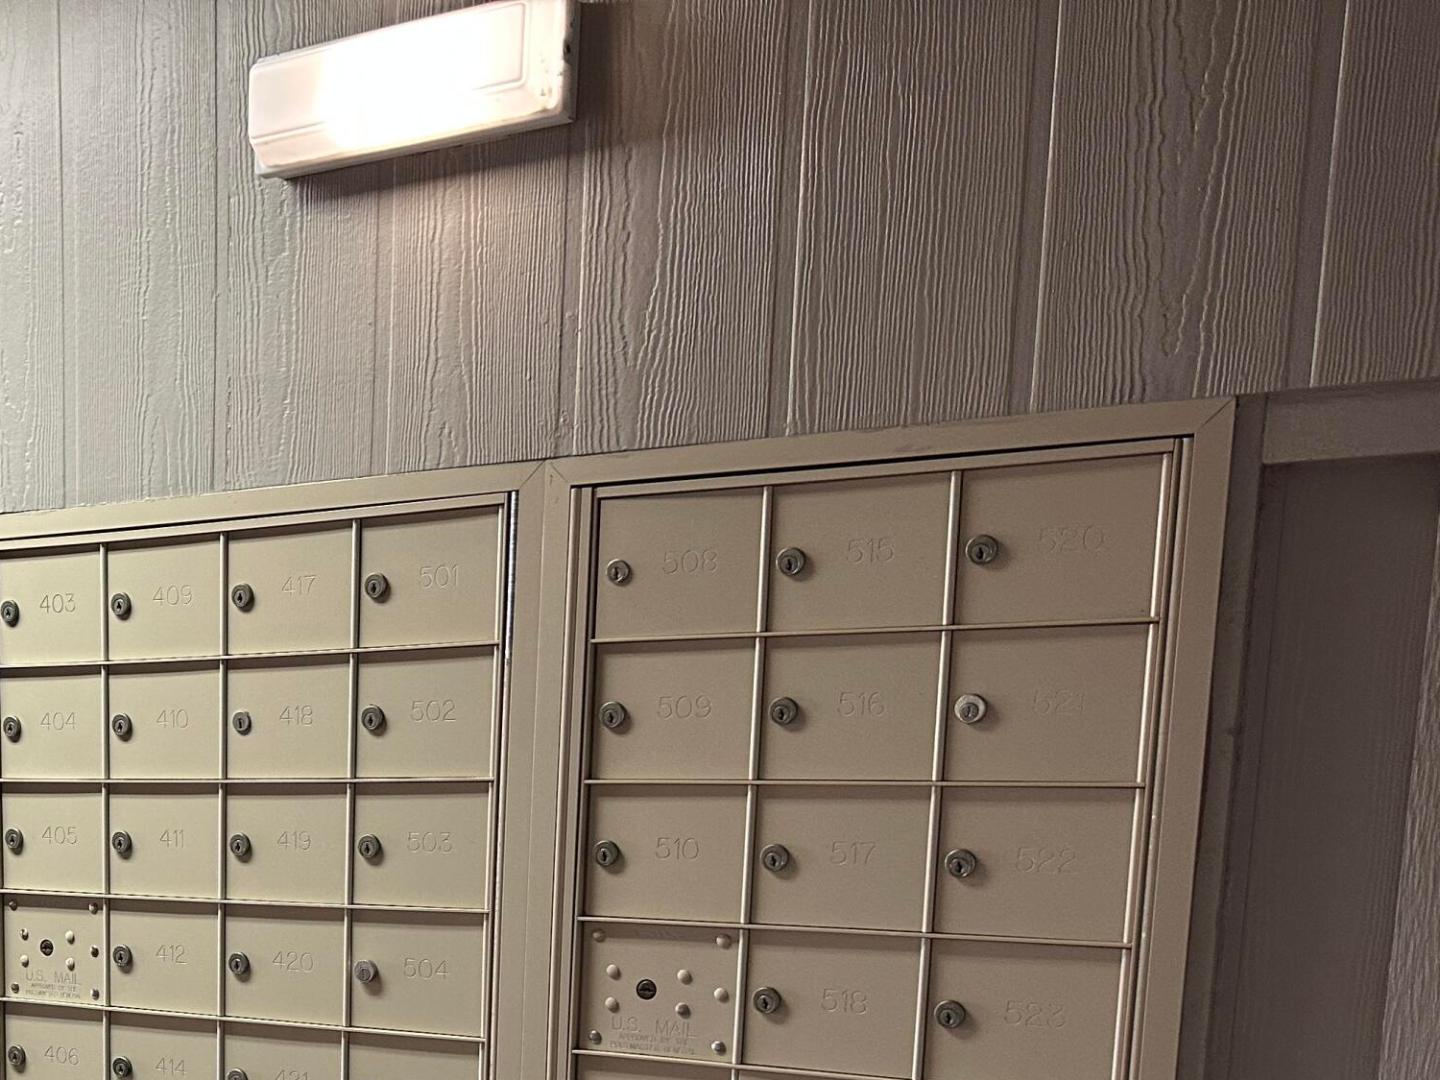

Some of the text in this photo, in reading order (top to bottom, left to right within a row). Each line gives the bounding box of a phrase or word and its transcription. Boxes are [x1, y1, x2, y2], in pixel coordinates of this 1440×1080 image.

[1037, 524, 1106, 553] 520
[847, 537, 894, 564] 515
[662, 549, 718, 576] 508
[281, 575, 319, 595] 417
[419, 564, 460, 587] 501
[40, 593, 76, 614] 403
[152, 585, 192, 606] 409
[410, 700, 457, 722] 502
[657, 695, 712, 721] 509
[837, 690, 885, 718] 516
[40, 712, 76, 730] 404
[156, 709, 189, 728] 410
[279, 705, 313, 726] 418
[42, 826, 78, 845] 405
[159, 829, 184, 849] 411
[277, 831, 311, 850] 419
[407, 832, 453, 853] 503
[654, 837, 700, 861] 510
[829, 841, 876, 866] 517
[1014, 847, 1076, 875] 522
[155, 943, 187, 964] 412
[272, 952, 313, 972] 420
[26, 970, 81, 986] U.S. MAIL
[403, 958, 448, 980] 504
[820, 988, 868, 1015] 518
[611, 1016, 699, 1040] U.S. MAIL
[44, 1045, 79, 1066] 406
[154, 1057, 186, 1076] 414
